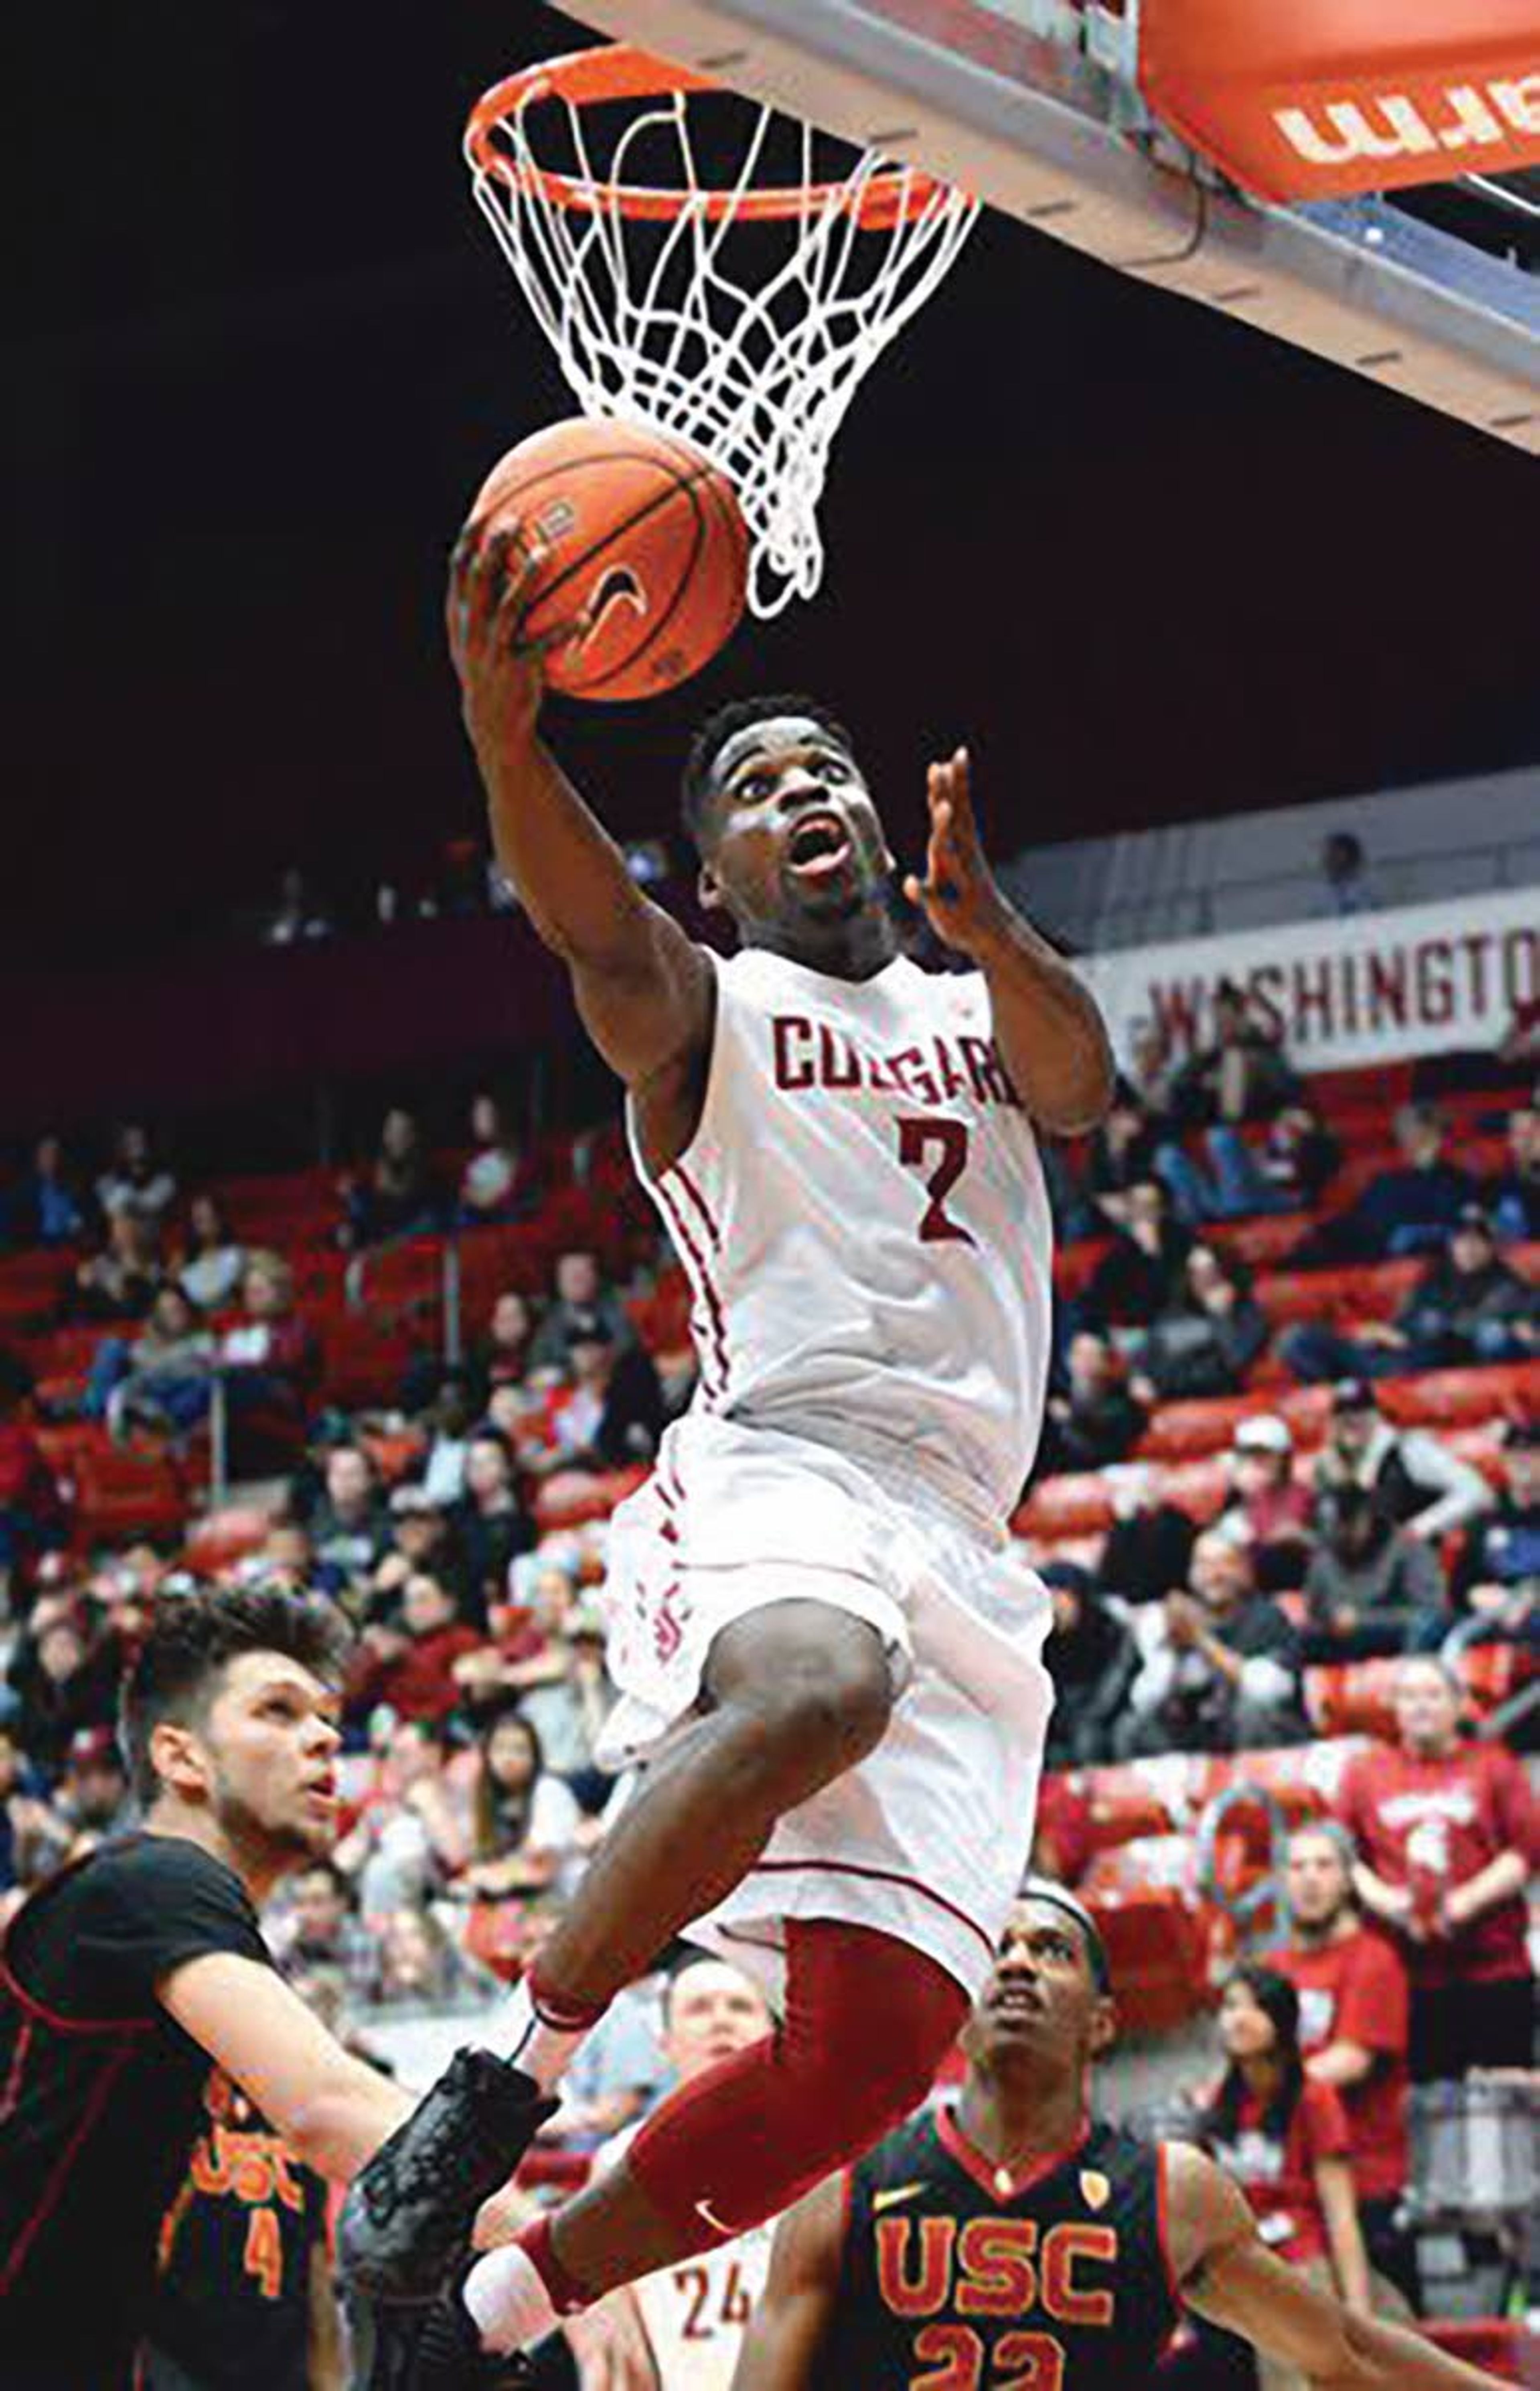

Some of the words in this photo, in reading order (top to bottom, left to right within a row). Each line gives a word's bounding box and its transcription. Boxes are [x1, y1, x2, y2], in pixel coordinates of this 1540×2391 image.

[895, 1117, 979, 1249] 2
[245, 2206, 281, 2299] 4
[675, 2262, 752, 2338] 24
[876, 2216, 1116, 2326] USC
